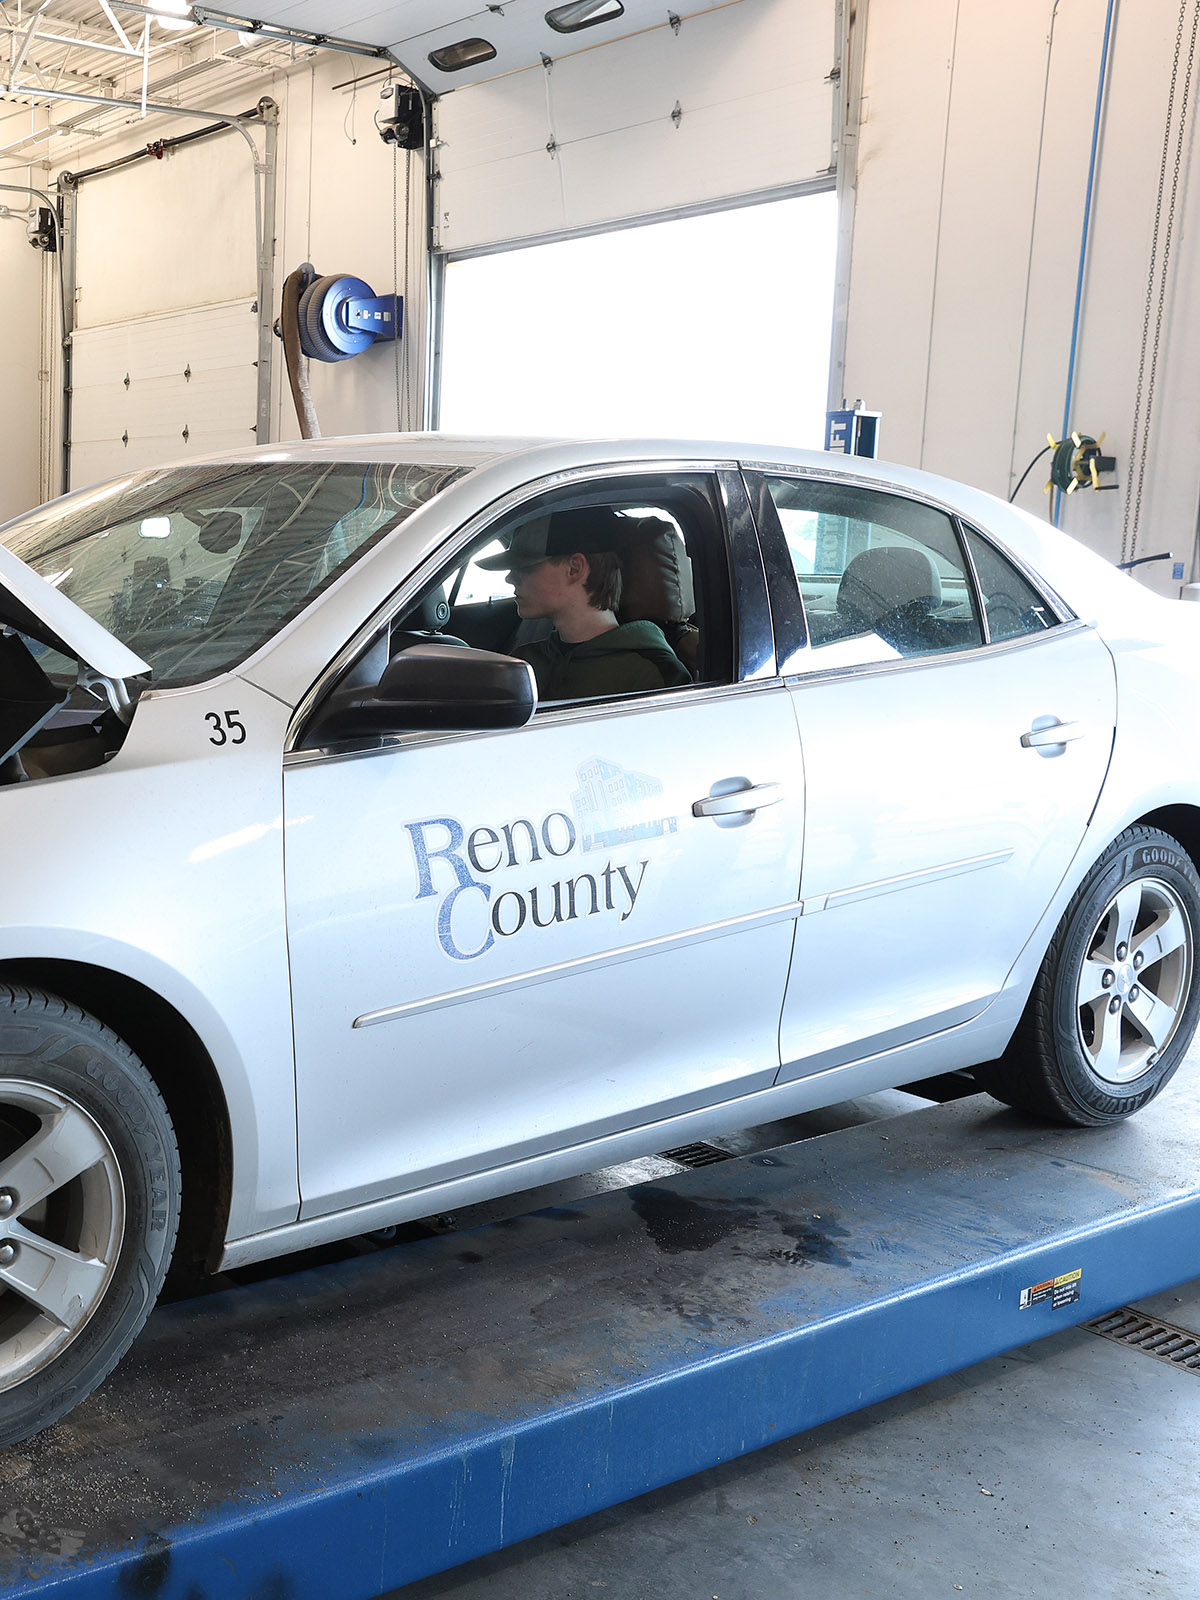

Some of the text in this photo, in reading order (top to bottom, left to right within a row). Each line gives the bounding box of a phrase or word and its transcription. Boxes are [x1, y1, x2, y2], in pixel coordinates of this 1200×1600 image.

[829, 420, 846, 453] IFT
[205, 710, 246, 746] 35
[404, 812, 576, 899] Reno
[438, 859, 648, 960] County
[86, 1056, 167, 1232] GOODYEAR
[1059, 1271, 1080, 1284] CAUTION
